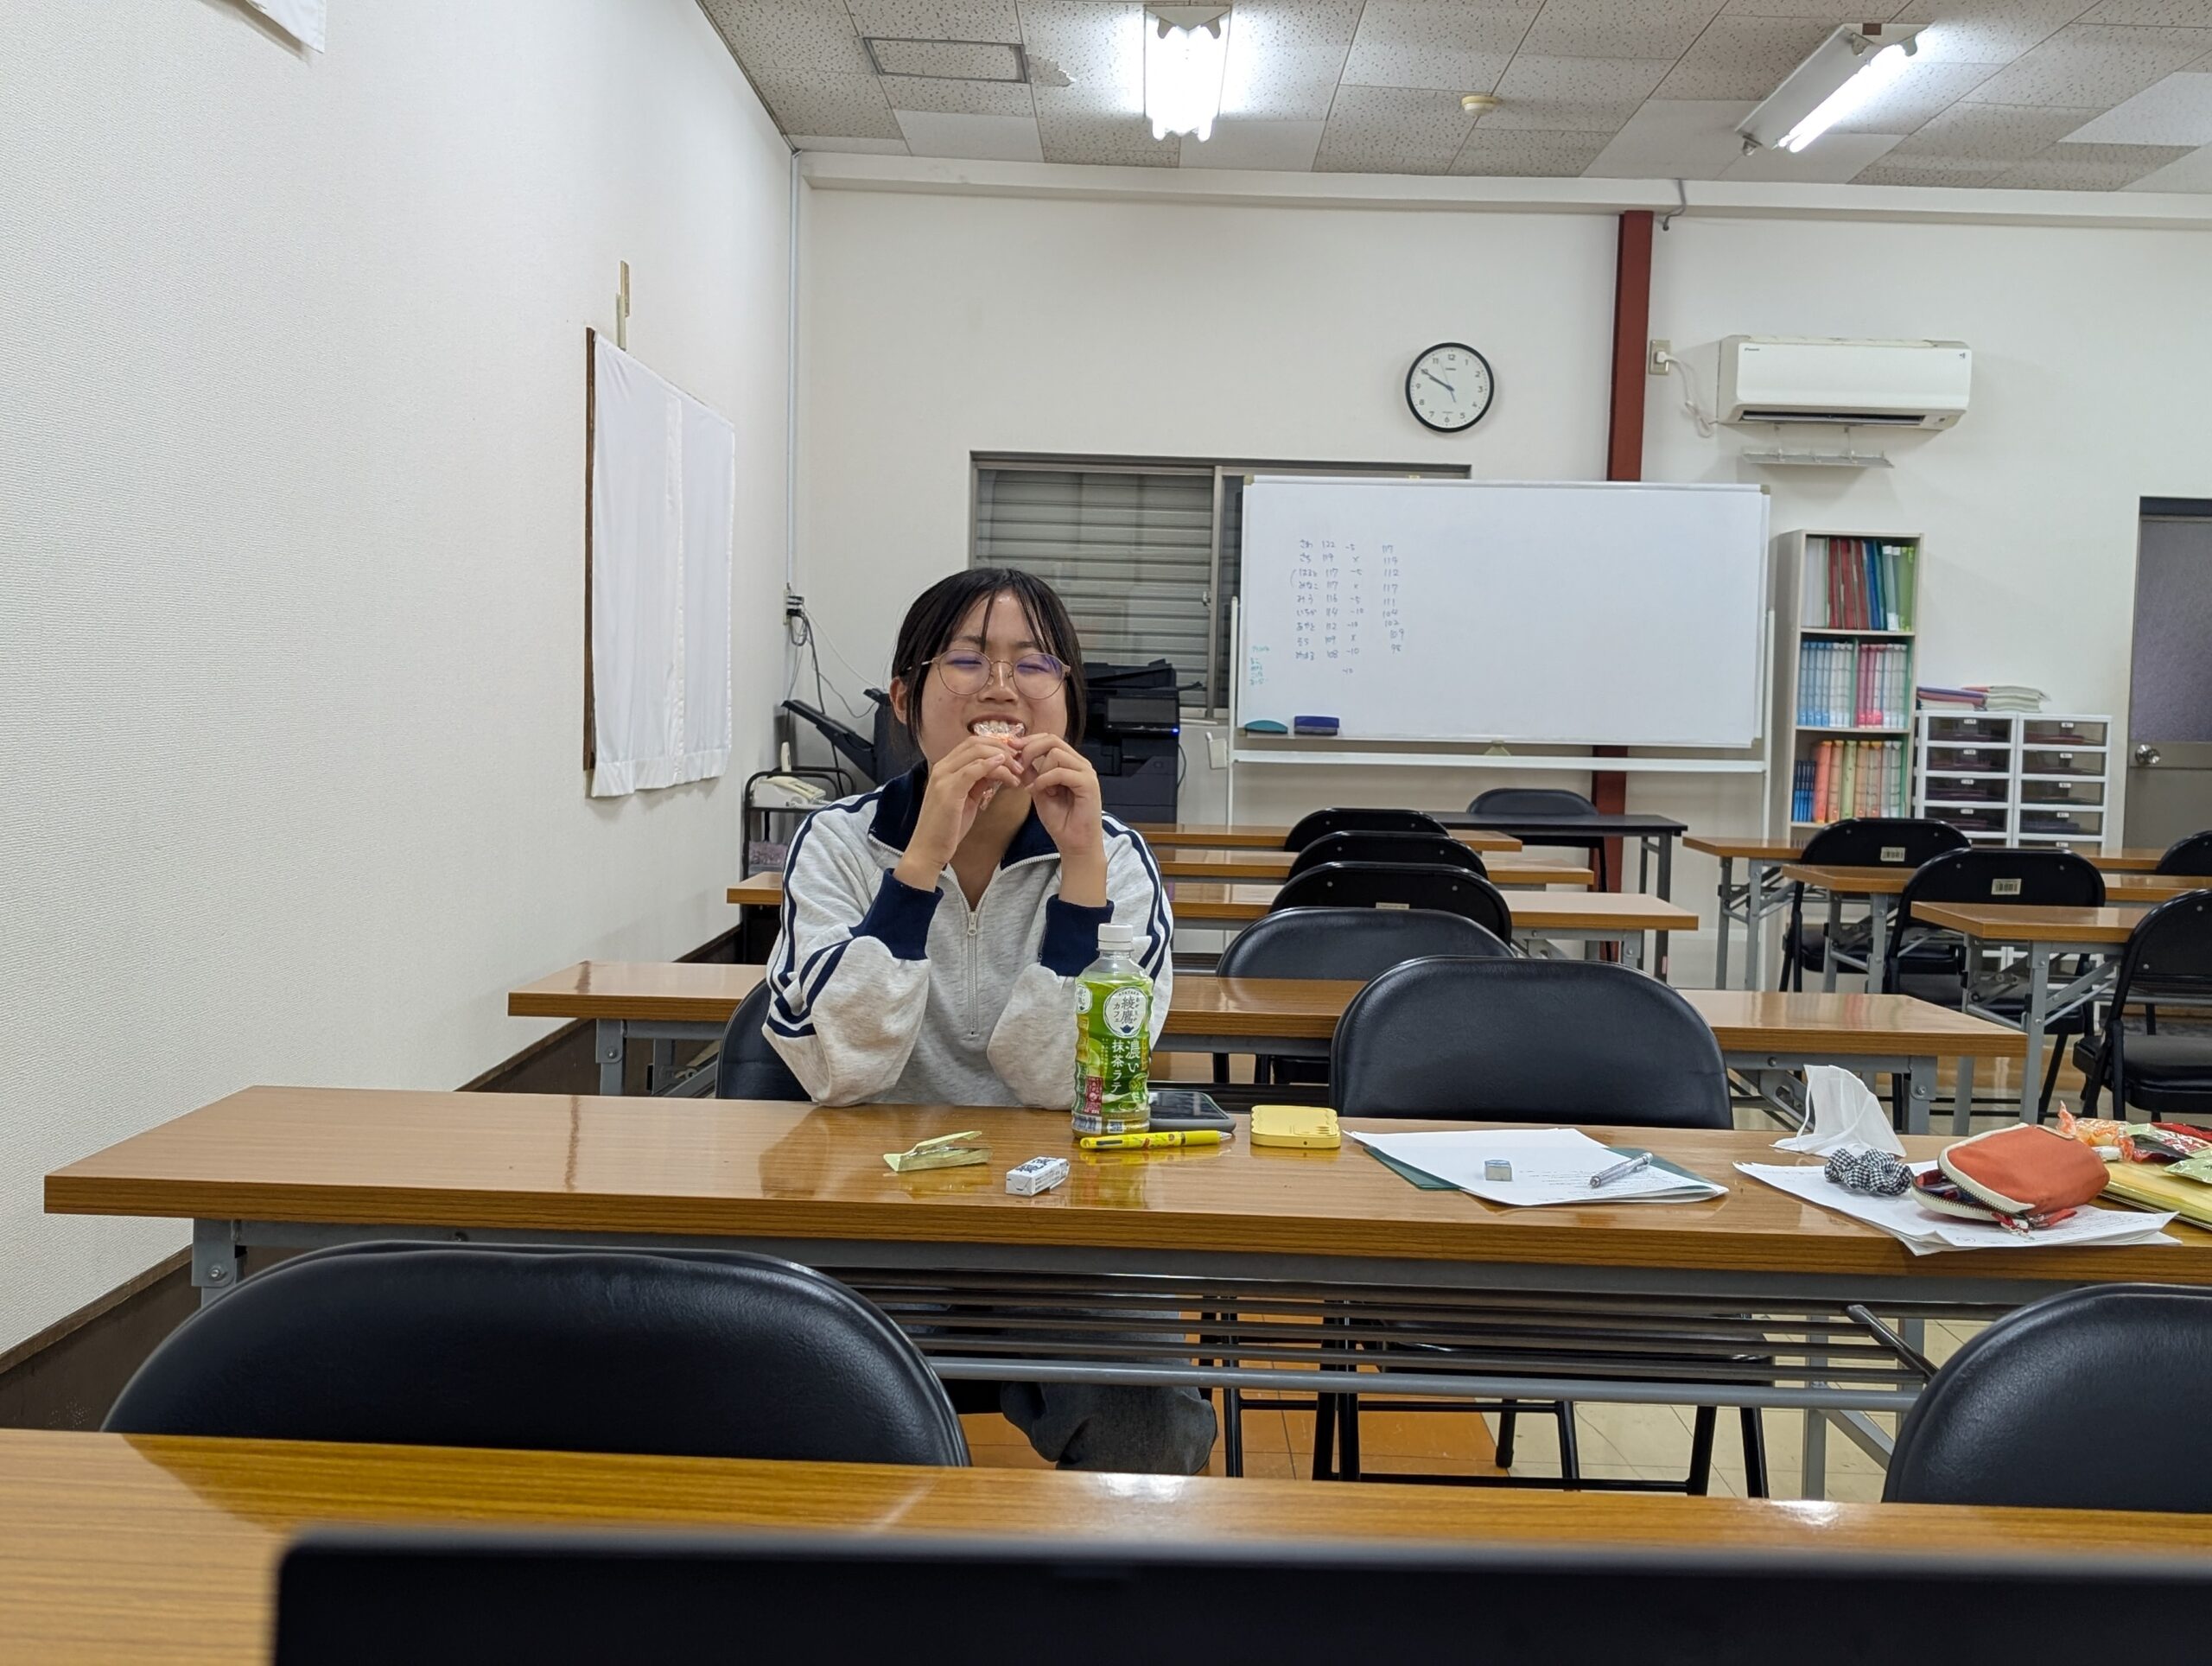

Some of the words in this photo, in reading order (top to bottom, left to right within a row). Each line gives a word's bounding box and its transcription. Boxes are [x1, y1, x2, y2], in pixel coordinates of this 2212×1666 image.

[1113, 1002, 1122, 1023] カフェ
[1121, 995, 1135, 1025] 綾鷹
[1110, 1039, 1125, 1093] 抹茶ラテ
[1125, 1039, 1141, 1073] 濃い
